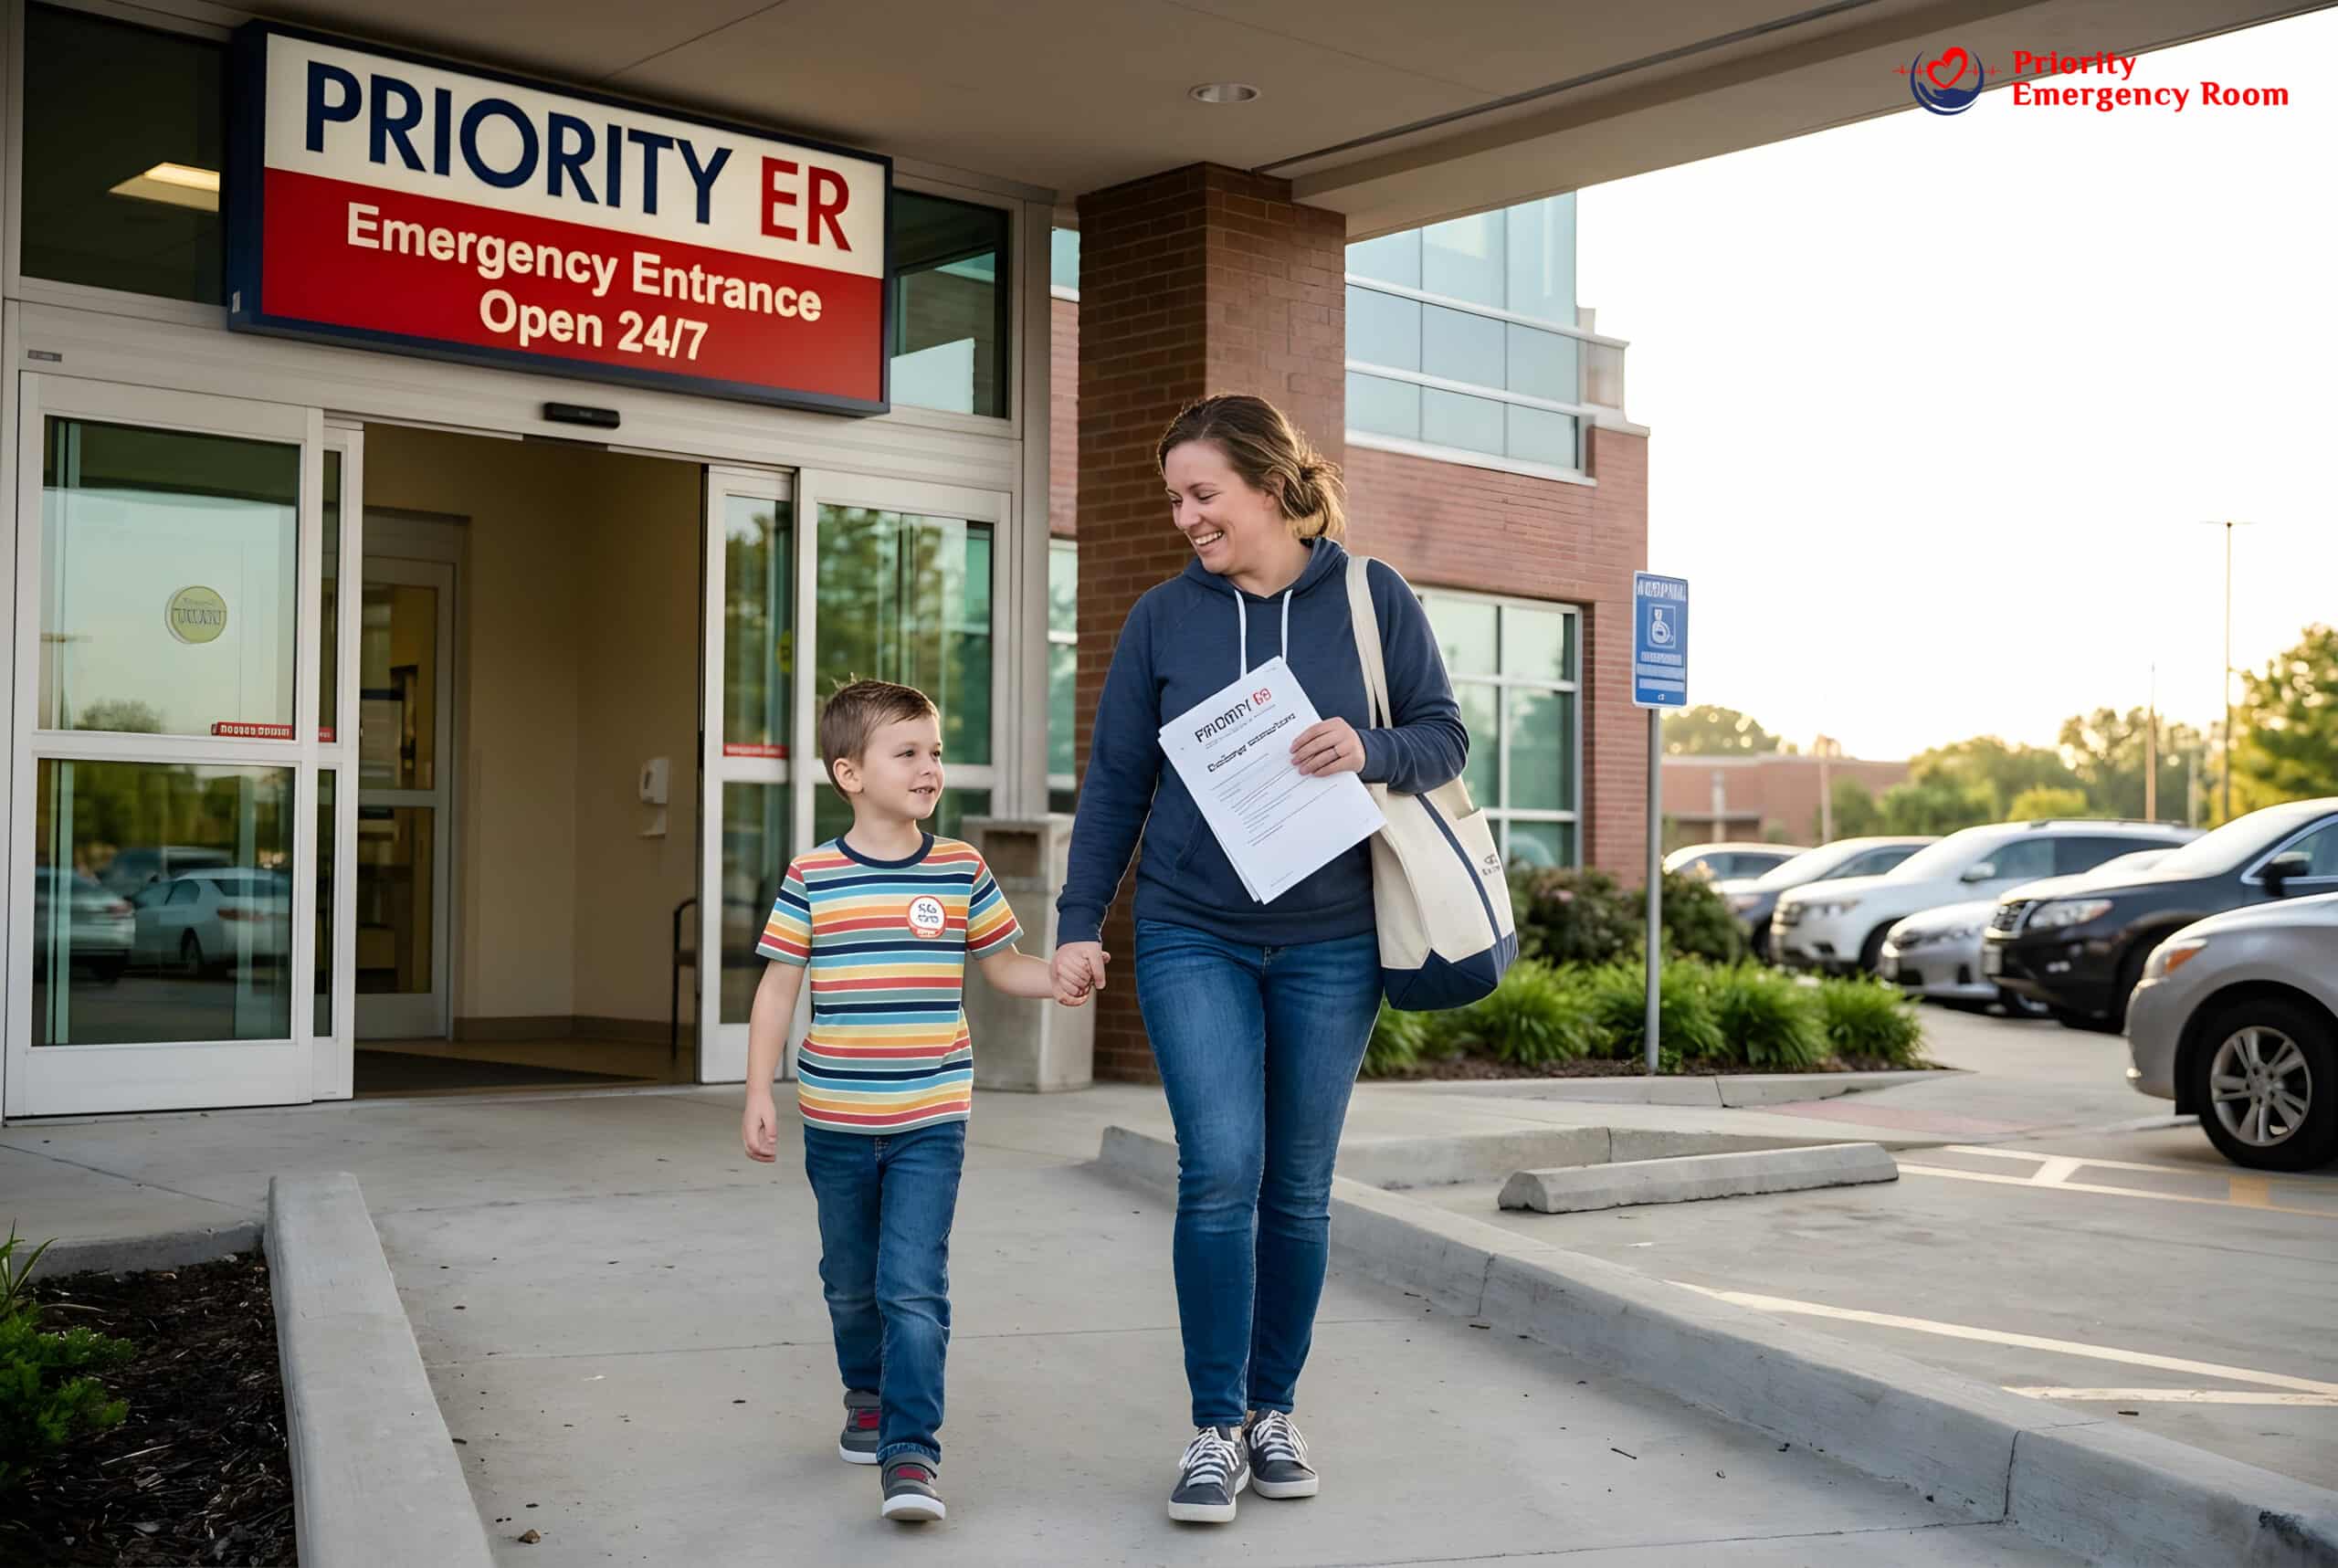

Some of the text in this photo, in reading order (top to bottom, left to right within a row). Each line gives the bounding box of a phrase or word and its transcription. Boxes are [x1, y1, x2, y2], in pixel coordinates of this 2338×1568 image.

[305, 59, 852, 252] PRIORITY ER
[347, 202, 823, 321] Emergency Entrance
[479, 289, 710, 361] Open 24/7
